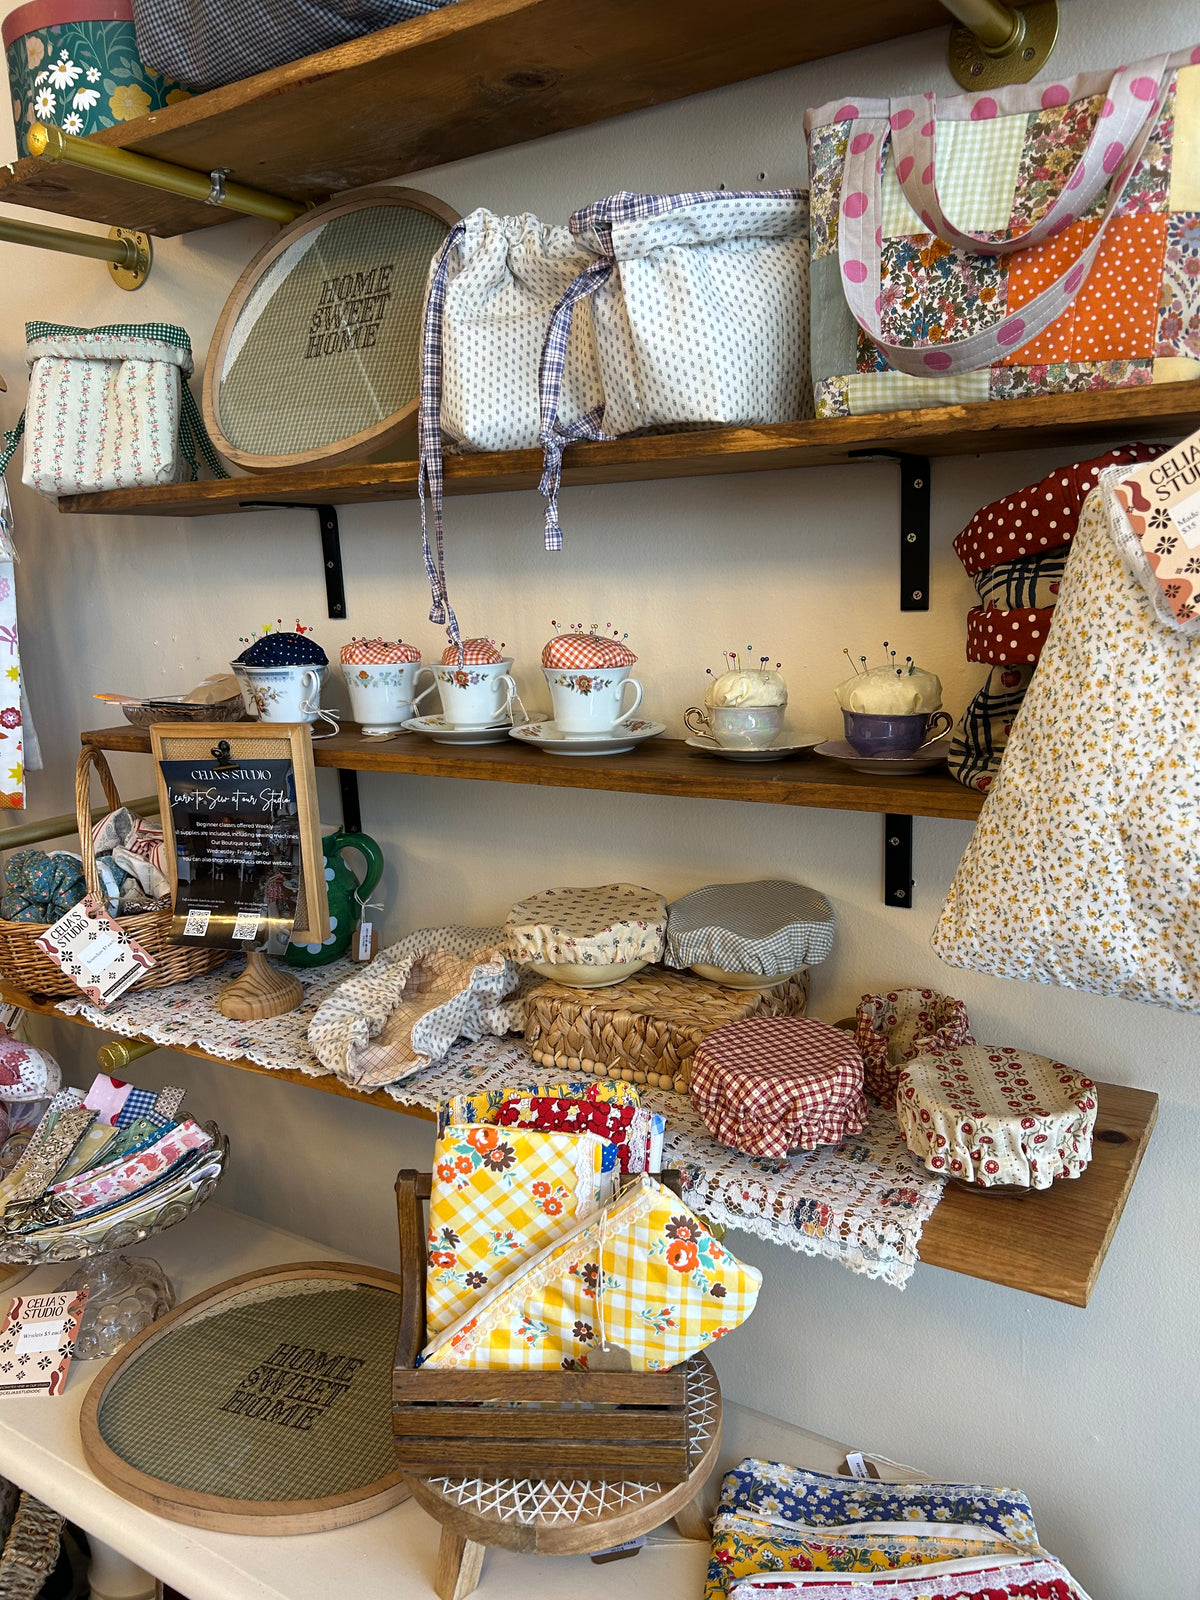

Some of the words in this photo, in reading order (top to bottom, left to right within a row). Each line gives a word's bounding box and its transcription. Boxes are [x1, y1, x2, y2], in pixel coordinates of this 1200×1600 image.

[318, 264, 393, 305] HOME
[310, 291, 392, 333] SWEET
[304, 322, 379, 358] HOME
[1150, 437, 1200, 485] CELIA
[232, 769, 271, 780] STUDIO
[205, 787, 230, 810] Sew
[260, 787, 291, 811] Studio
[50, 911, 82, 940] CELIA'S
[57, 919, 89, 948] STUDIO
[22, 1306, 64, 1320] STUDIO
[27, 1295, 67, 1309] CELIA'S
[263, 1343, 365, 1383] HOME
[238, 1365, 350, 1408] SWEET
[218, 1390, 326, 1430] HOME
